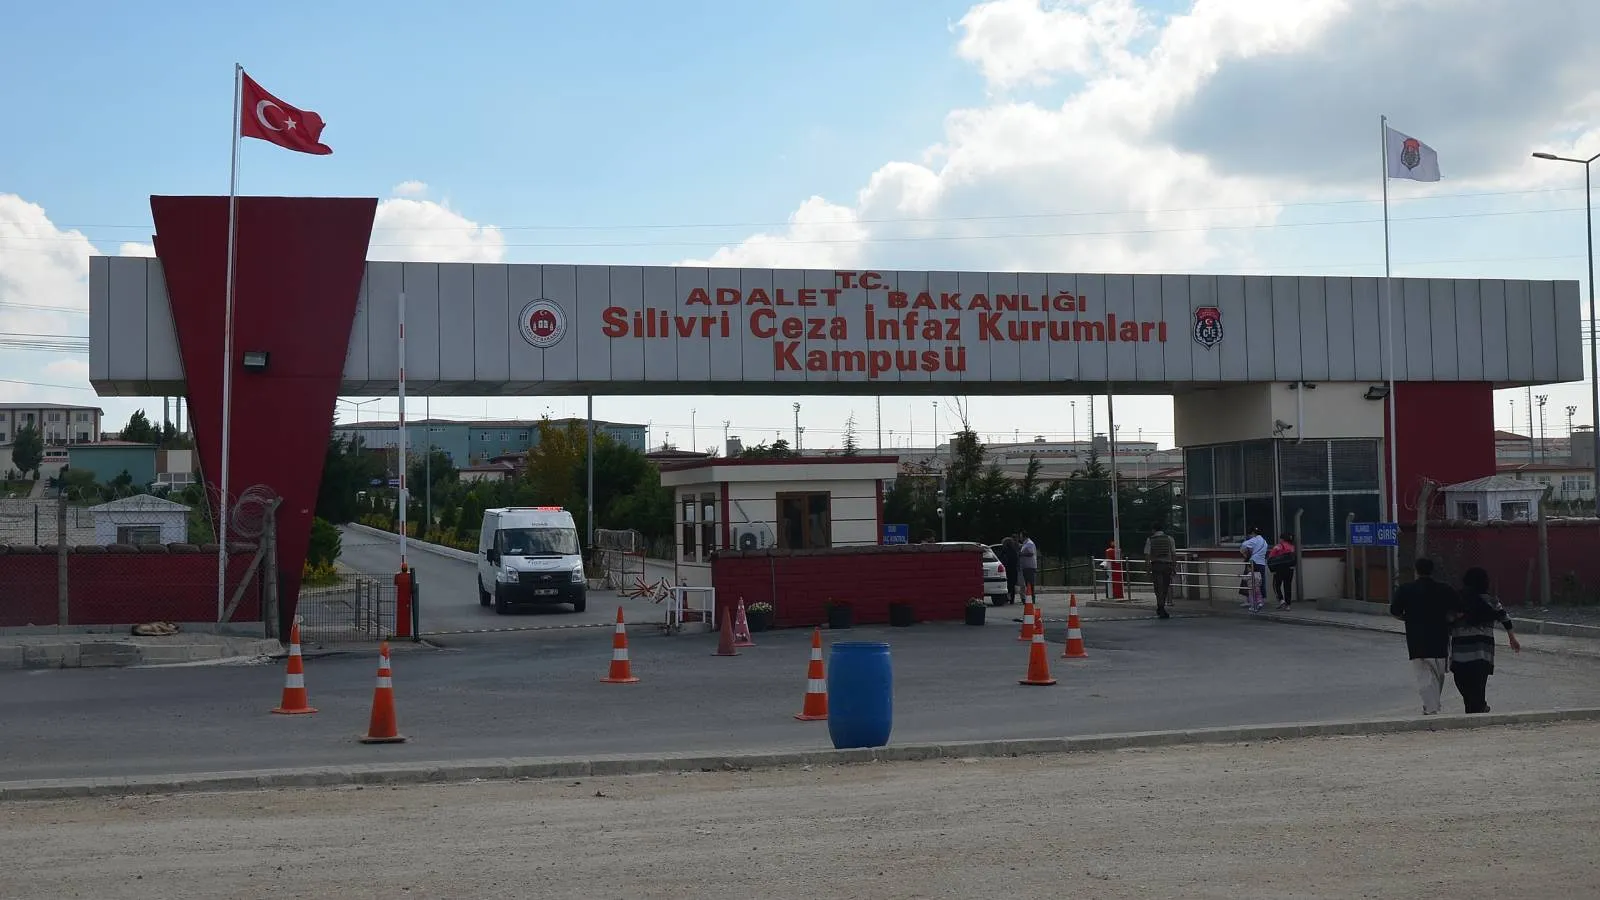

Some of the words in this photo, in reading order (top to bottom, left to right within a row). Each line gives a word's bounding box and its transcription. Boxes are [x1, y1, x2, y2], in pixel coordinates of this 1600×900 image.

[836, 272, 889, 290] T.C.
[686, 288, 842, 306] ADALET
[888, 290, 1086, 313] BAKANLIĞI
[602, 306, 729, 338] Silivri
[750, 307, 848, 341] Ceza
[865, 304, 960, 342] İnfaz
[979, 312, 1167, 342] Kurumları
[774, 340, 966, 378] Kampusü
[1377, 525, 1397, 544] GİRİŞ
